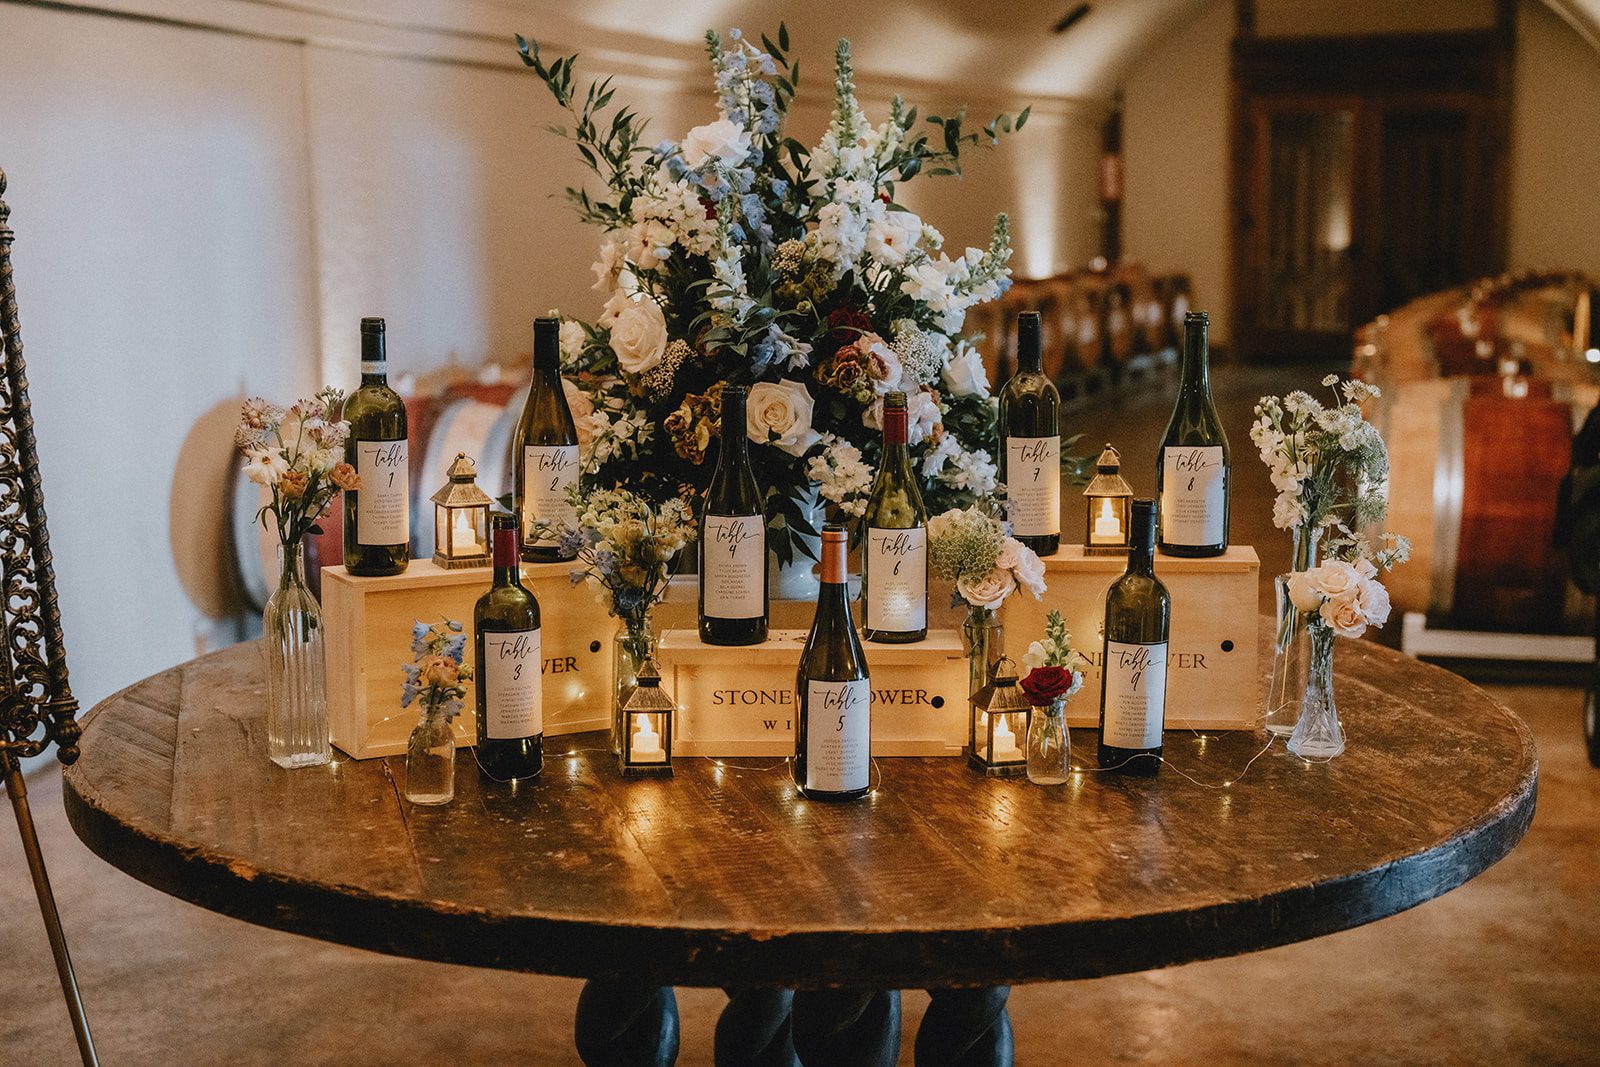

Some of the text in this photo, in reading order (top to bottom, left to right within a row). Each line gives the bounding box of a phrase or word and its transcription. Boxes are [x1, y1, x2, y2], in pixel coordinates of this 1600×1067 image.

[364, 443, 408, 467] table
[529, 449, 578, 471] table
[1011, 440, 1059, 463] table
[1168, 449, 1220, 472] table
[389, 471, 395, 488] 1
[550, 476, 559, 492] 2
[1033, 467, 1041, 482] 7
[1187, 476, 1195, 492] 8
[708, 520, 760, 543] table
[729, 544, 737, 559] 4
[872, 532, 924, 556] table
[893, 560, 901, 576] 6
[489, 635, 540, 660] table
[1111, 646, 1164, 670] table
[513, 663, 522, 681] 3
[1131, 671, 1142, 691] 9
[712, 690, 792, 705] STONE
[813, 685, 868, 710] table
[836, 715, 846, 732] 5
